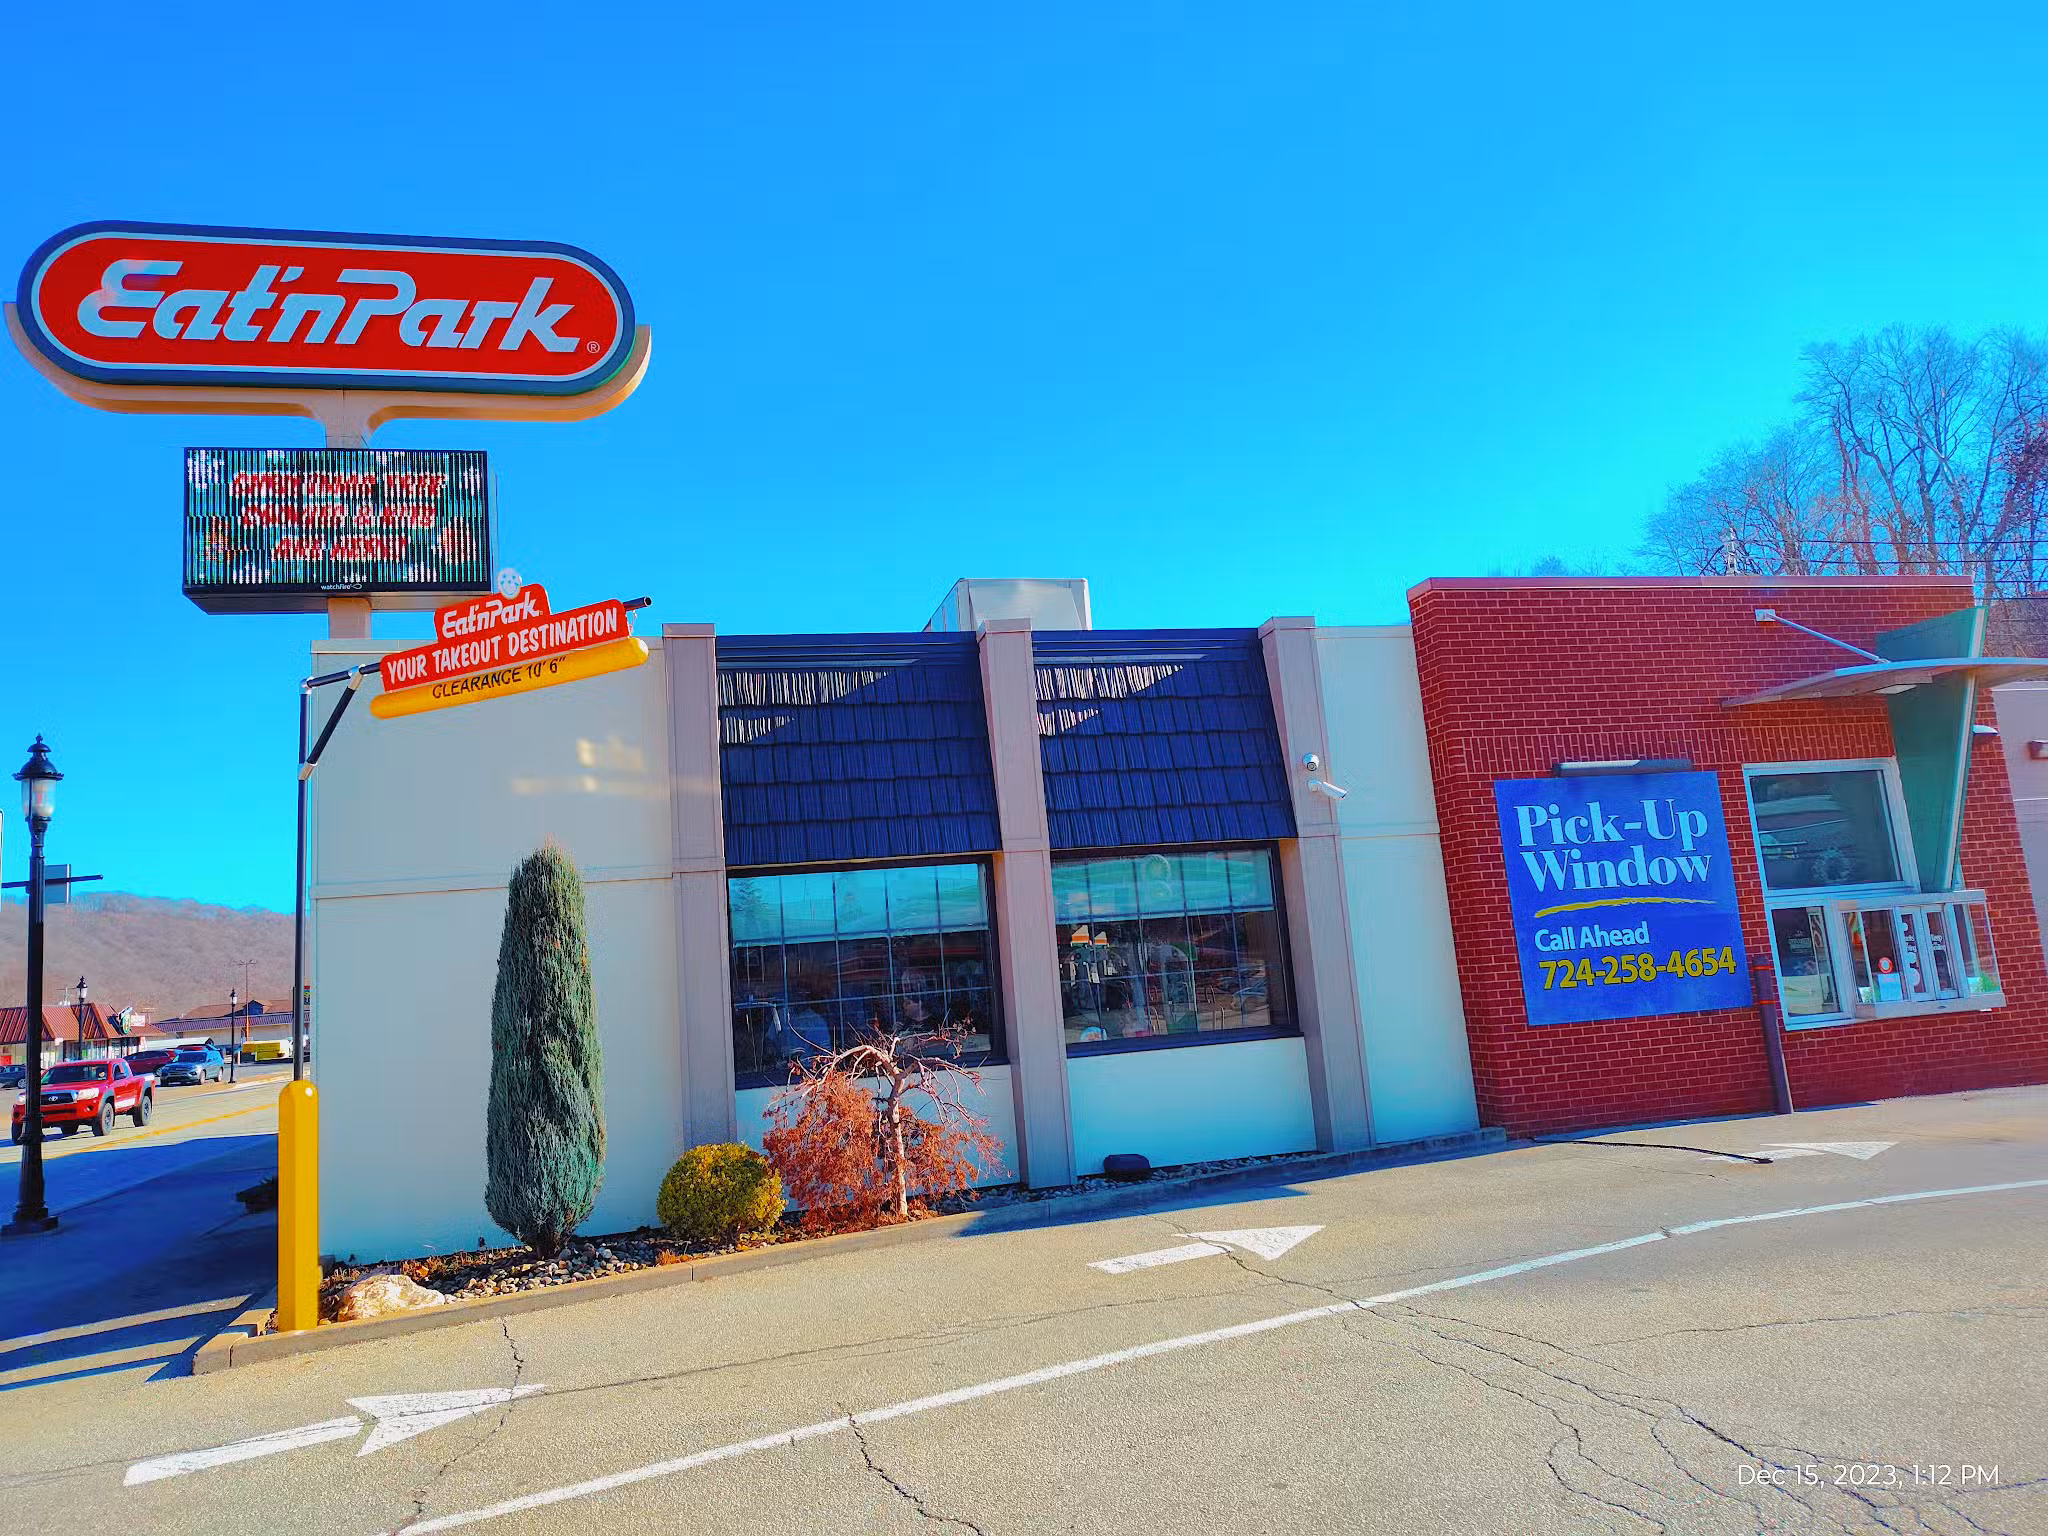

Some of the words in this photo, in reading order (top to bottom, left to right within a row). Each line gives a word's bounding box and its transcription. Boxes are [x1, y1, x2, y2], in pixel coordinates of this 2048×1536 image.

[387, 657, 428, 685] YOUR
[432, 636, 502, 674] TAKEOUT
[508, 607, 618, 658] DESTINATION
[432, 669, 522, 699] CLEARANCE
[1514, 799, 1708, 852] Pick-Up
[1520, 845, 1712, 893] Window
[1534, 926, 1576, 952] Call
[1580, 921, 1650, 949] Ahead
[1539, 946, 1737, 990] 724-258-4654
